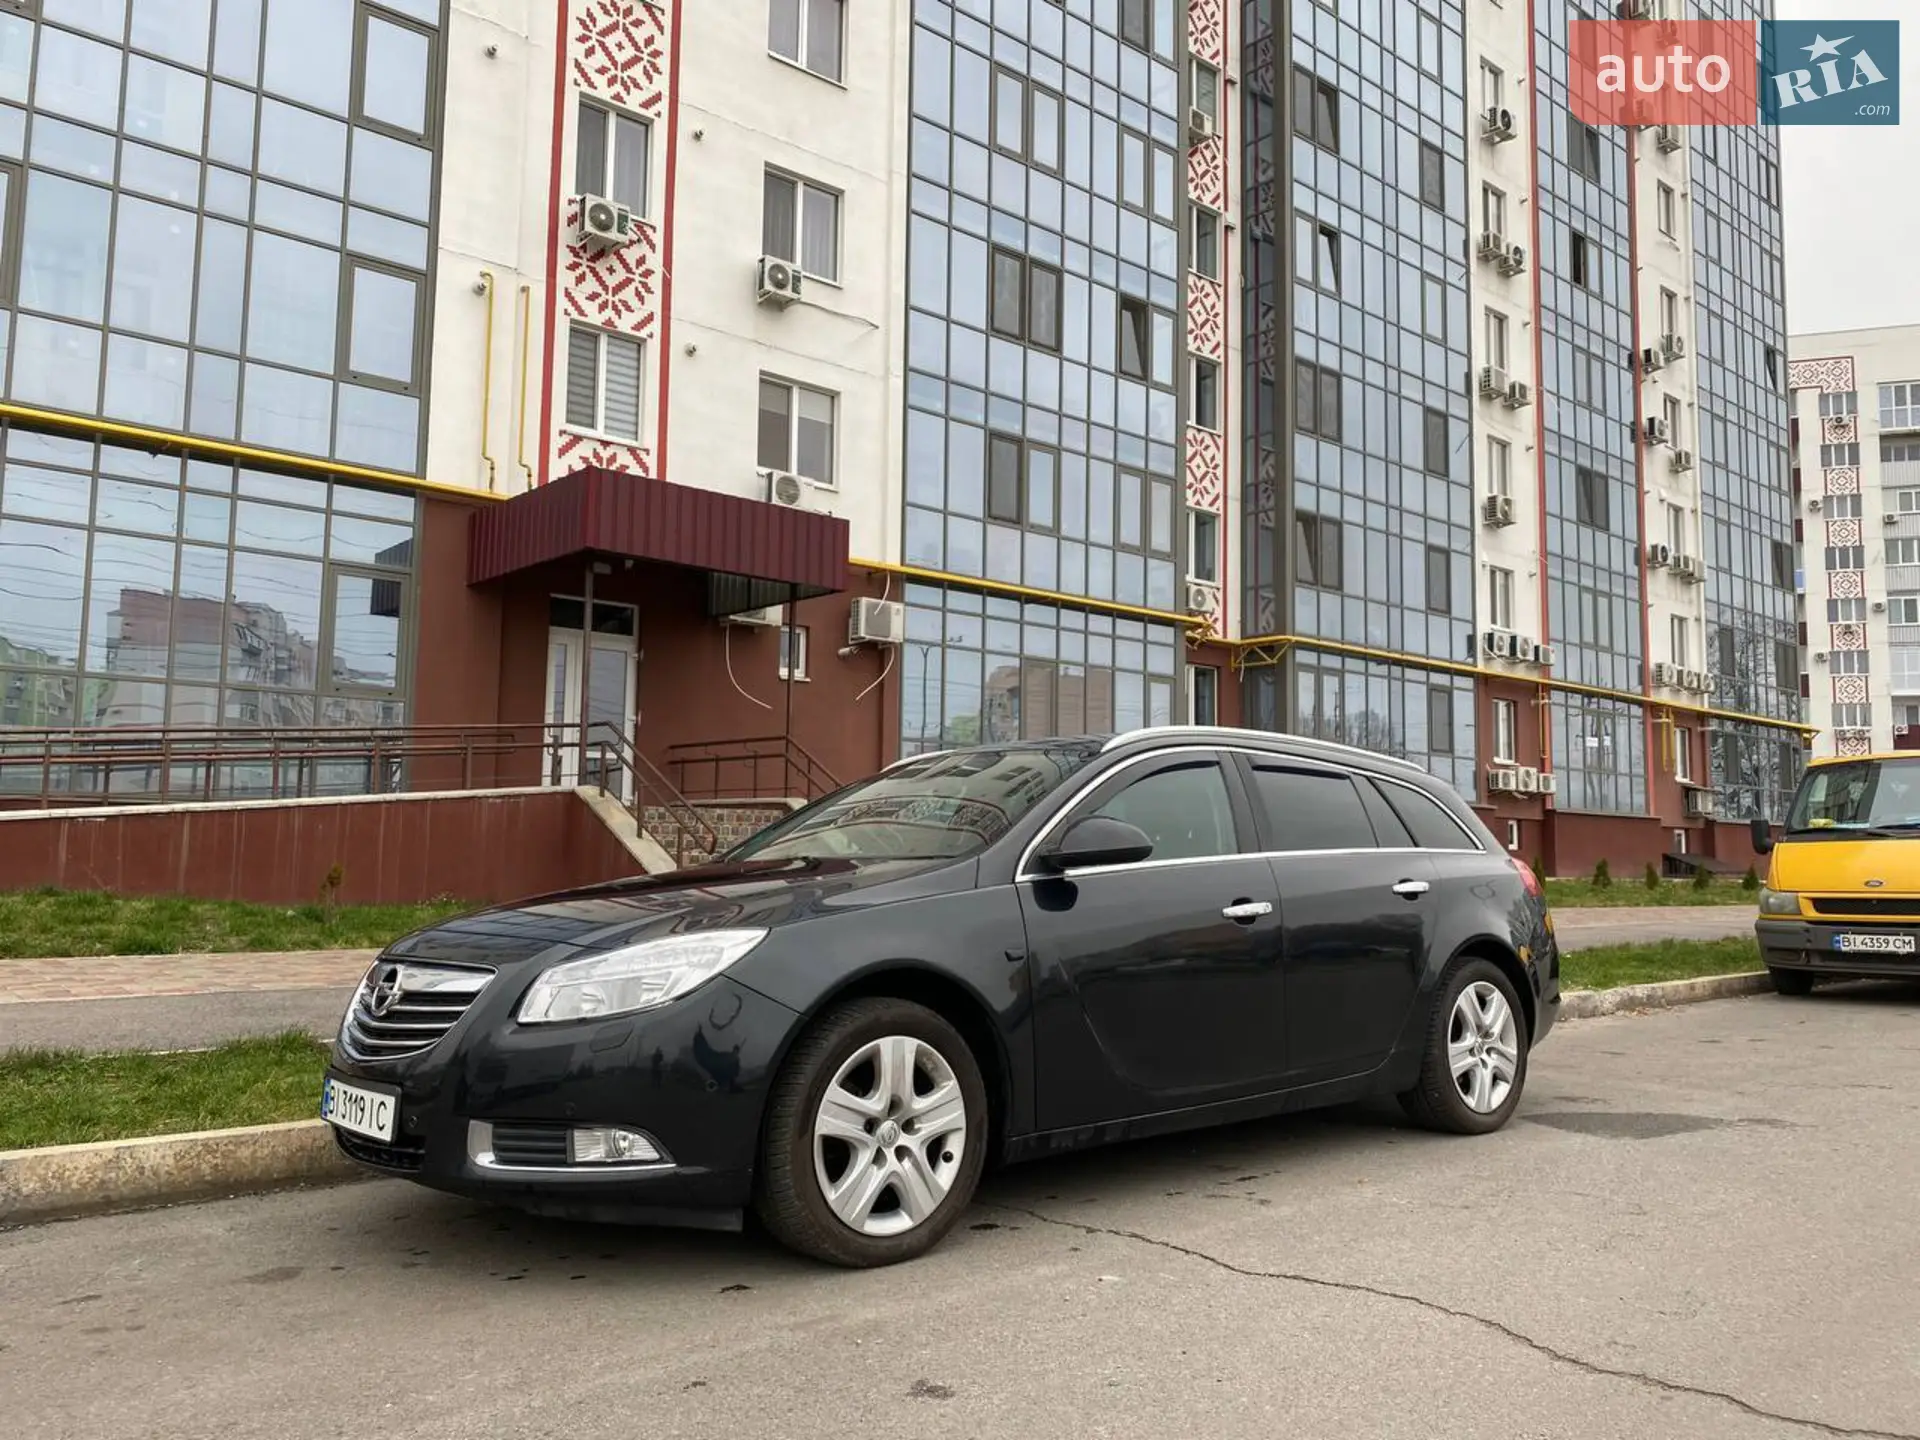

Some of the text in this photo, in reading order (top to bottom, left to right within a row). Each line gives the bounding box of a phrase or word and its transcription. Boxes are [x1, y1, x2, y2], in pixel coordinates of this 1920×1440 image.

[1861, 937, 1890, 949] 4359
[1893, 938, 1912, 950] CM
[341, 1090, 366, 1126] 3119
[369, 1098, 388, 1132] IC
